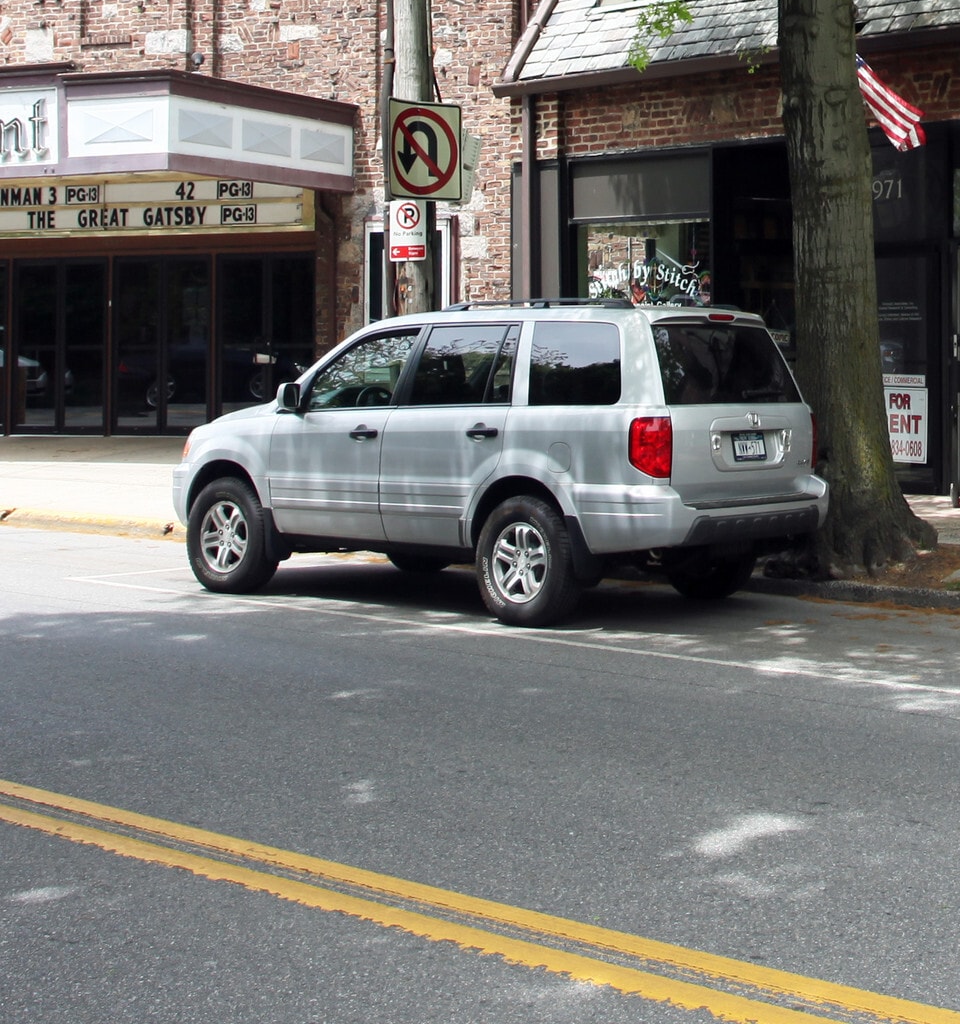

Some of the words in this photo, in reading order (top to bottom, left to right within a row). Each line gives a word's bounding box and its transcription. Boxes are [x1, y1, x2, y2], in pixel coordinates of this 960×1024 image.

[0, 187, 42, 206] NMAN
[48, 186, 57, 205] 3
[67, 187, 98, 203] PG-13
[175, 181, 195, 201] 42
[219, 181, 252, 198] PG-13
[872, 179, 902, 200] 971
[27, 210, 56, 229] THE
[77, 207, 129, 228] GREAT
[143, 206, 207, 226] GATSBY
[222, 206, 255, 223] PG-13
[633, 259, 650, 287] by
[656, 263, 698, 297] Stitch
[889, 393, 911, 410] FOR
[889, 414, 922, 434] ENT
